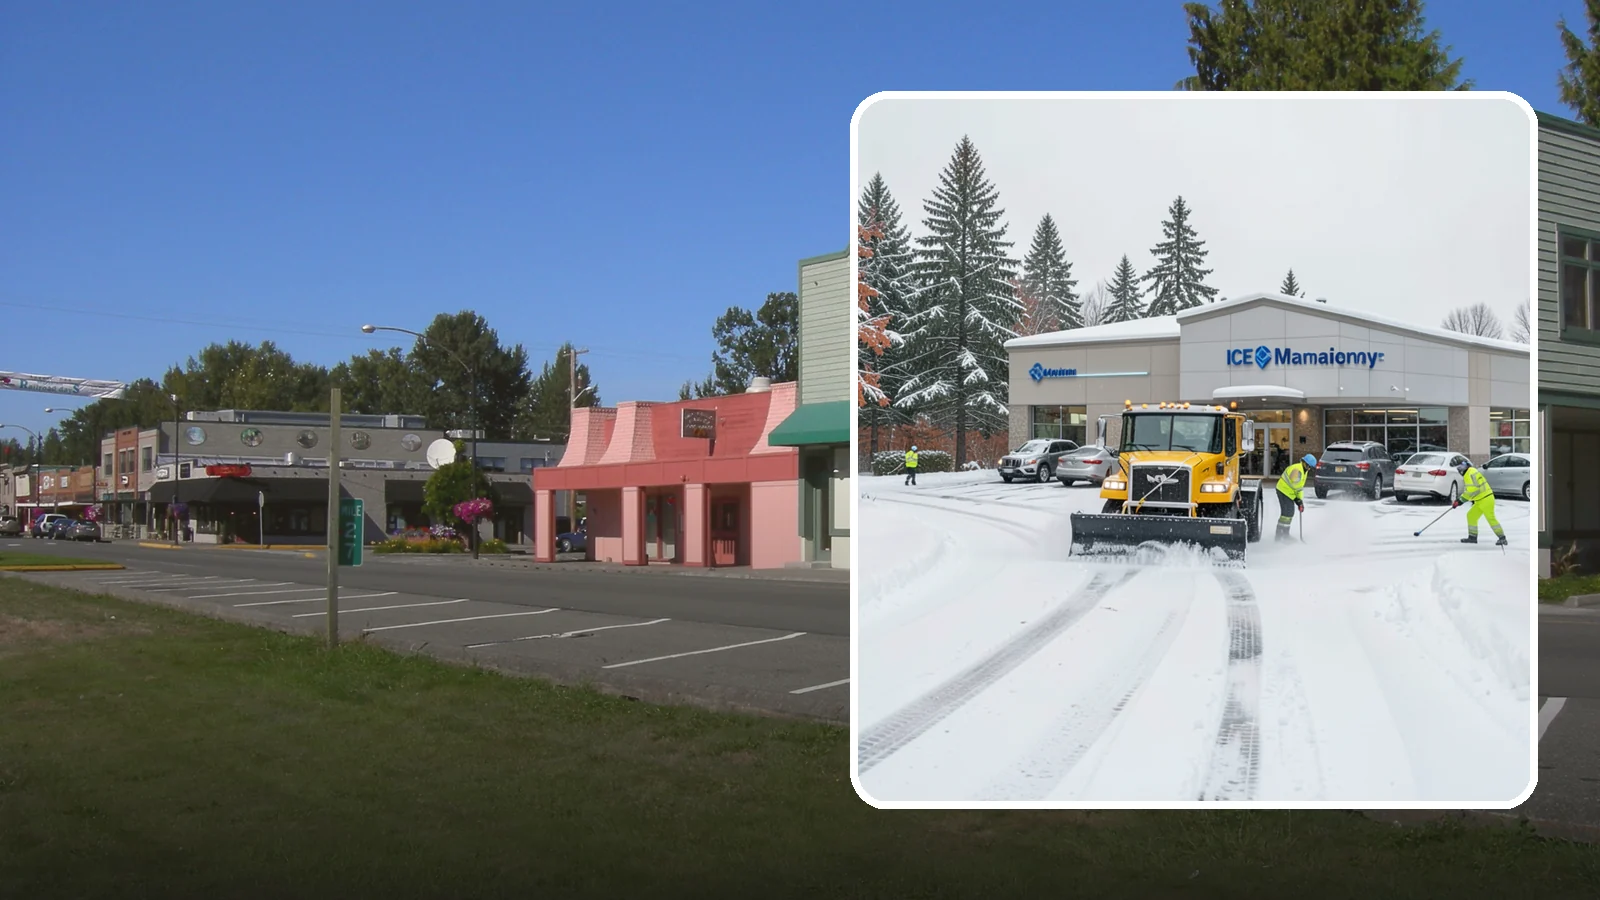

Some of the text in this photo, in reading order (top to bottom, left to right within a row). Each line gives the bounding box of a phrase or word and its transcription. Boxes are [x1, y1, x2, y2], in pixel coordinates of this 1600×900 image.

[1226, 348, 1254, 365] ICE
[341, 505, 362, 517] MILE
[344, 522, 357, 539] 2
[344, 542, 356, 560] 7
